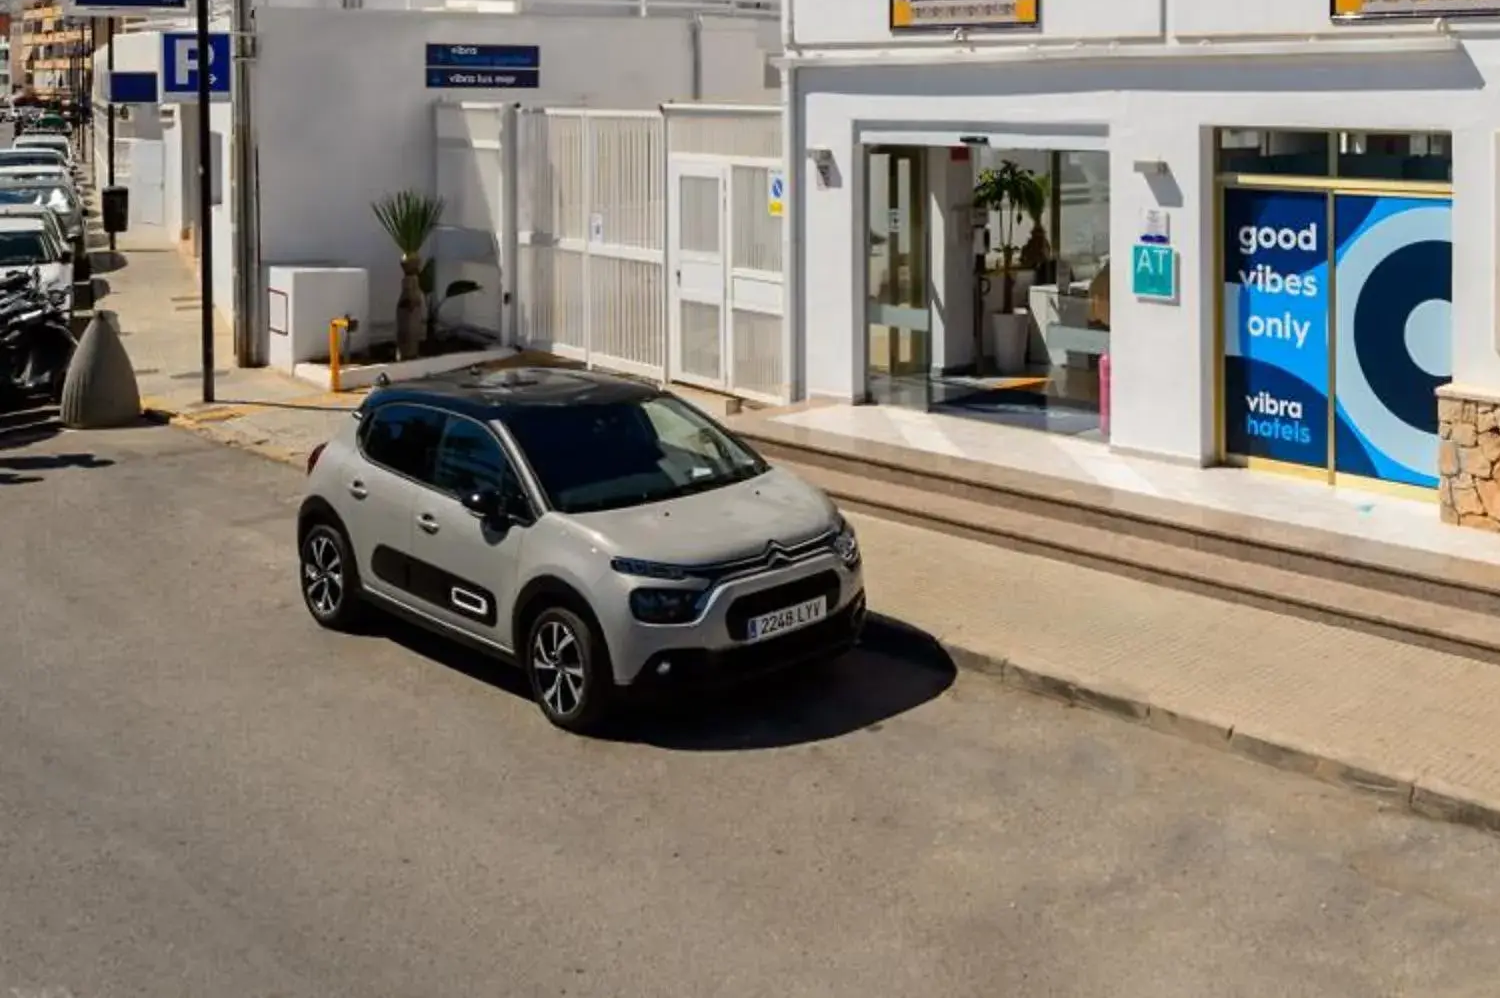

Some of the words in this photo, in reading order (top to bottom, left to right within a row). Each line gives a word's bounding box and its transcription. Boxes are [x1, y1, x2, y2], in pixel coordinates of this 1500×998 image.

[175, 39, 215, 85] P
[1239, 222, 1317, 254] good
[1136, 248, 1169, 275] AT
[1238, 264, 1317, 296] vibes
[1248, 311, 1311, 349] only
[1245, 391, 1303, 419] vibra
[1246, 414, 1311, 444] hotels
